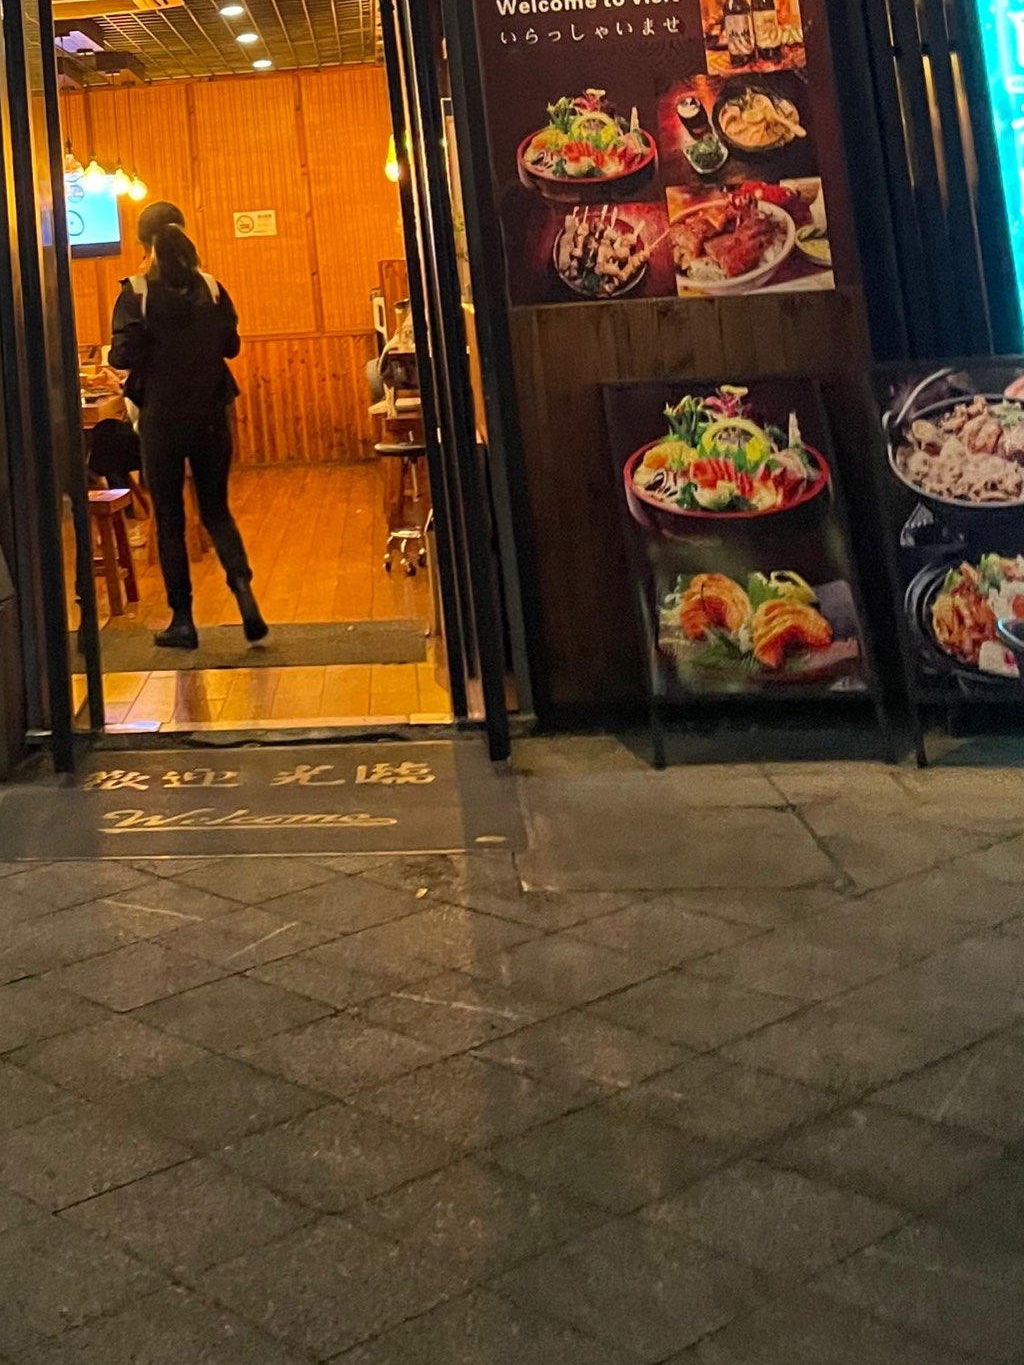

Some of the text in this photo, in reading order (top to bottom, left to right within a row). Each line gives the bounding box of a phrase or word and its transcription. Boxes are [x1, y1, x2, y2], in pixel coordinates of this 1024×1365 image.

[500, 17, 681, 45] いらっしゃいませ
